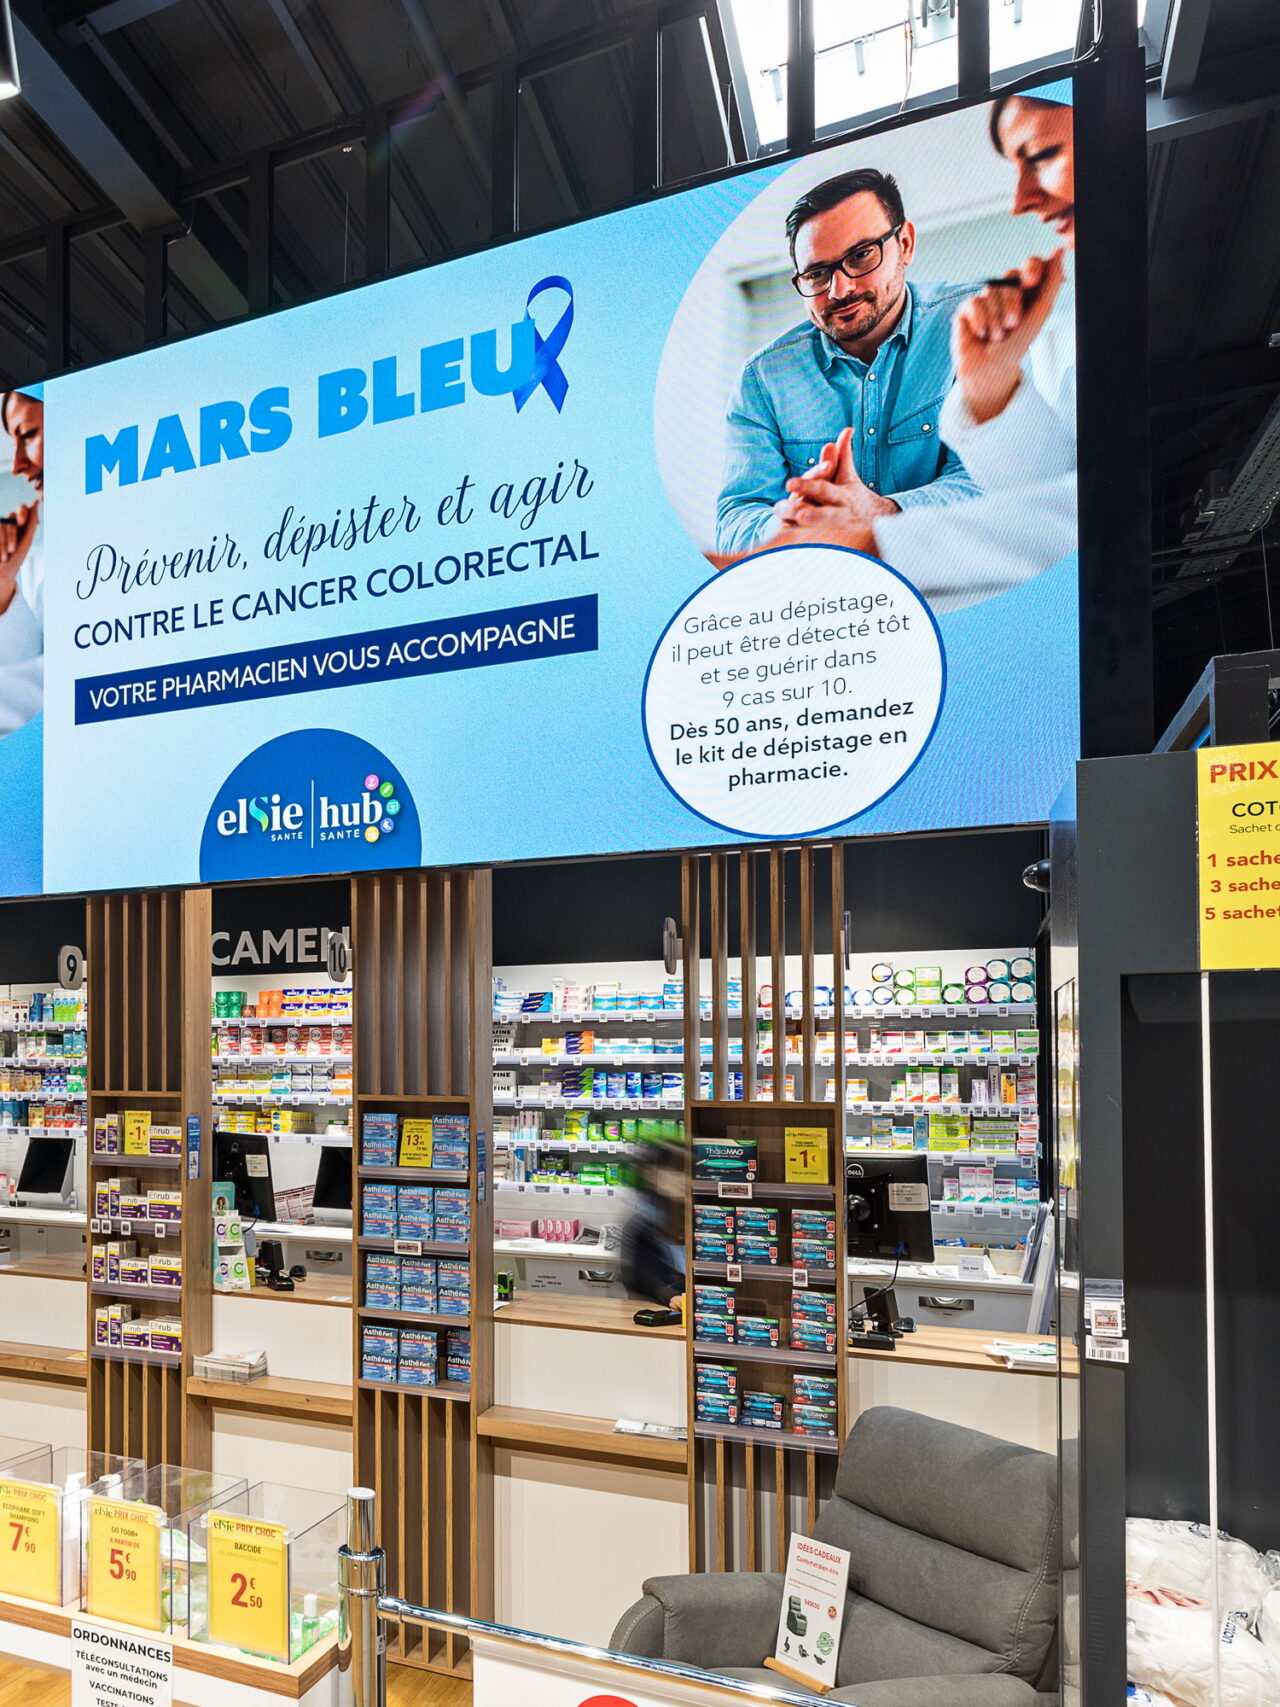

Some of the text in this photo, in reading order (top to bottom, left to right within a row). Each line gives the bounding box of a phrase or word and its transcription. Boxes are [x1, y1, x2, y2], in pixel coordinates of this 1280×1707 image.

[85, 318, 536, 494] MARS BLEU
[76, 458, 594, 600] Prévenir, dépister et agir
[74, 530, 599, 650] CONTRE LE CANCER COLORECTAL
[684, 592, 894, 634] Grâce au dépistage,
[672, 614, 910, 664] il peut être détecté tôt
[89, 615, 576, 710] VOTRE PHARMACIEN VOUS ACCOMPAGNE
[701, 649, 877, 684] et se guérir dans
[722, 678, 852, 708] 9 cas sur 10.
[671, 699, 914, 741] Dès 50 ans, demandez
[676, 729, 907, 765] le kit de dépistage en
[728, 761, 848, 791] pharmacie.
[1210, 760, 1279, 783] PRIX
[320, 792, 383, 830] hub
[1232, 801, 1280, 817] COT
[271, 828, 360, 842] SANTÉ SANTÉ
[1229, 824, 1272, 834] Sachet
[1207, 854, 1216, 867] 1
[1211, 880, 1221, 893] 3
[1205, 907, 1215, 920] 5
[65, 954, 78, 982] 9
[331, 942, 346, 973] 10
[13, 1489, 47, 1502] PRIX CHOC
[114, 1510, 149, 1523] PRIX CHOC
[236, 1525, 276, 1538] PRIX CHOC
[234, 1543, 261, 1554] BACCIDE
[797, 1542, 841, 1564] IDÉES CADEAUX
[74, 1628, 171, 1663] ORDONNANCES
[76, 1650, 168, 1682] TÉLÉCONSULTATIONS
[86, 1663, 158, 1689] avec un médecin
[89, 1680, 154, 1705] VACCINATIONS
